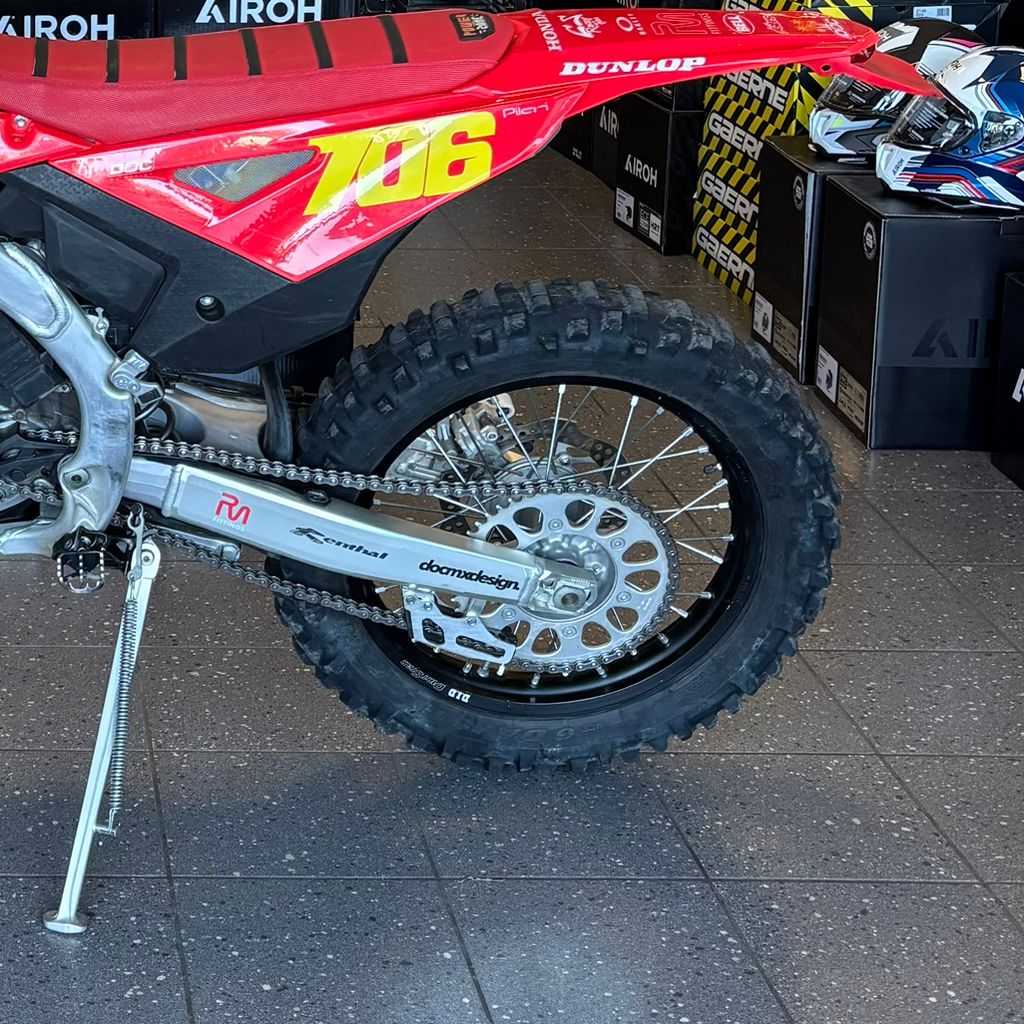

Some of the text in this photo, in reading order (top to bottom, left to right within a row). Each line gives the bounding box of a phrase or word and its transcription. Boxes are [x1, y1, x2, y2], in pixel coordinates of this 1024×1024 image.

[559, 57, 707, 76] DUNLOP
[599, 105, 620, 140] AIR
[303, 111, 497, 217] 106
[624, 153, 658, 189] AIROH
[696, 225, 756, 292] GAERN
